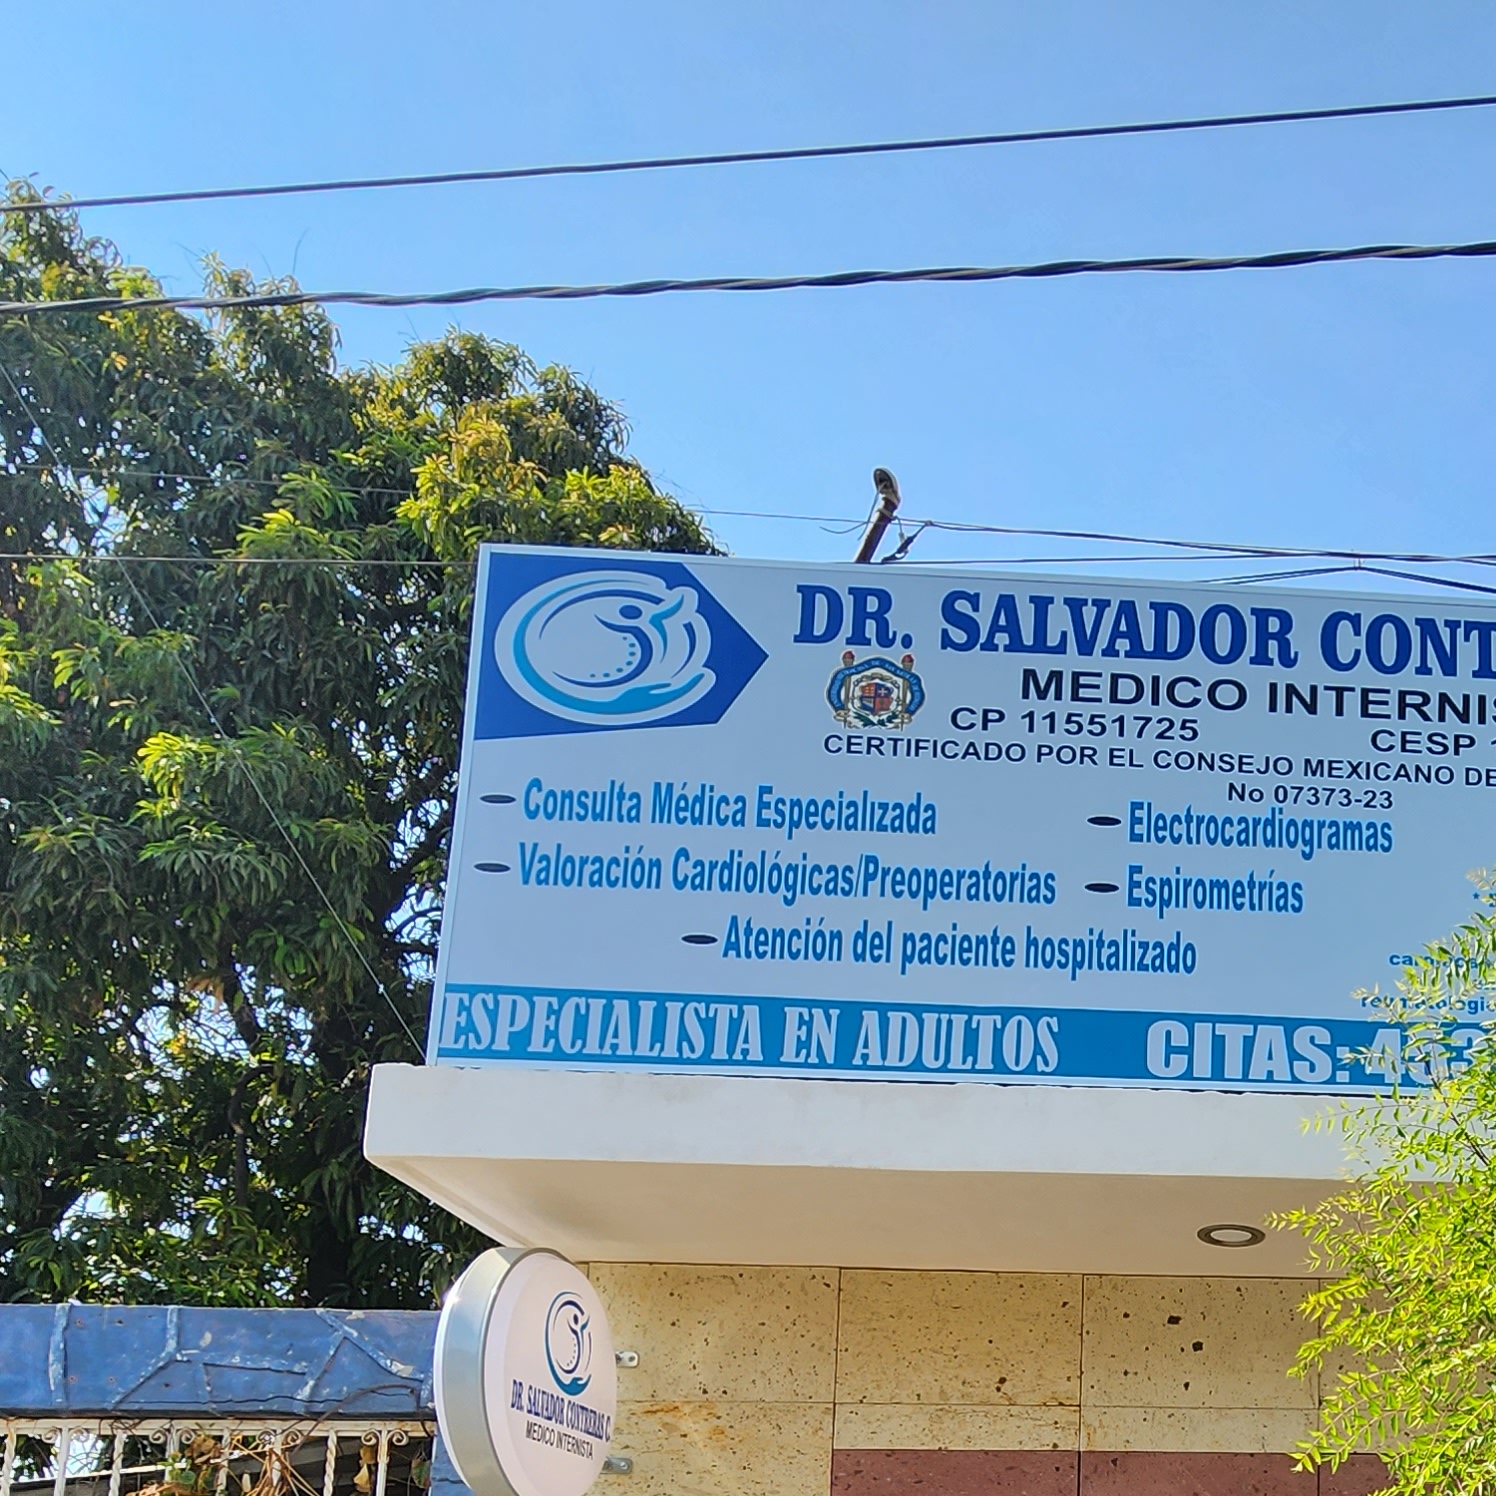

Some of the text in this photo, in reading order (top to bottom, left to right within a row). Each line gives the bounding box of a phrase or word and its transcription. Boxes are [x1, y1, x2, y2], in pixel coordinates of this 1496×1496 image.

[793, 584, 913, 650] DR.
[940, 590, 1299, 669] SALVADOR
[1021, 668, 1248, 711] MEDICO
[950, 707, 1199, 742] CP 11551725
[1370, 729, 1476, 757] CESP
[824, 734, 1026, 762] CERTIFICADO
[1036, 744, 1098, 766] POR
[1108, 747, 1144, 768] EL
[1153, 750, 1294, 776] CONSEJO
[1303, 758, 1455, 785] MEXICANO
[523, 777, 937, 841] Consulta Médica Especializada
[1228, 782, 1393, 810] No 07373-23
[1128, 800, 1393, 861] Electrocardiogramas
[519, 841, 1056, 912] Valoración Cardiológicas/Preoperatorias
[1127, 864, 1304, 920] Espirometrías
[722, 914, 1197, 982] Atención del paciente hospitalizado
[440, 992, 1060, 1073] ESPECIALISTA EN ADULTOS
[1147, 1020, 1350, 1082] CITAS:
[510, 1379, 524, 1411] DR.
[526, 1384, 565, 1426] SALVADOR
[566, 1399, 604, 1441] CONTRERAS
[526, 1419, 593, 1460] MEDICO INTERNISTA
